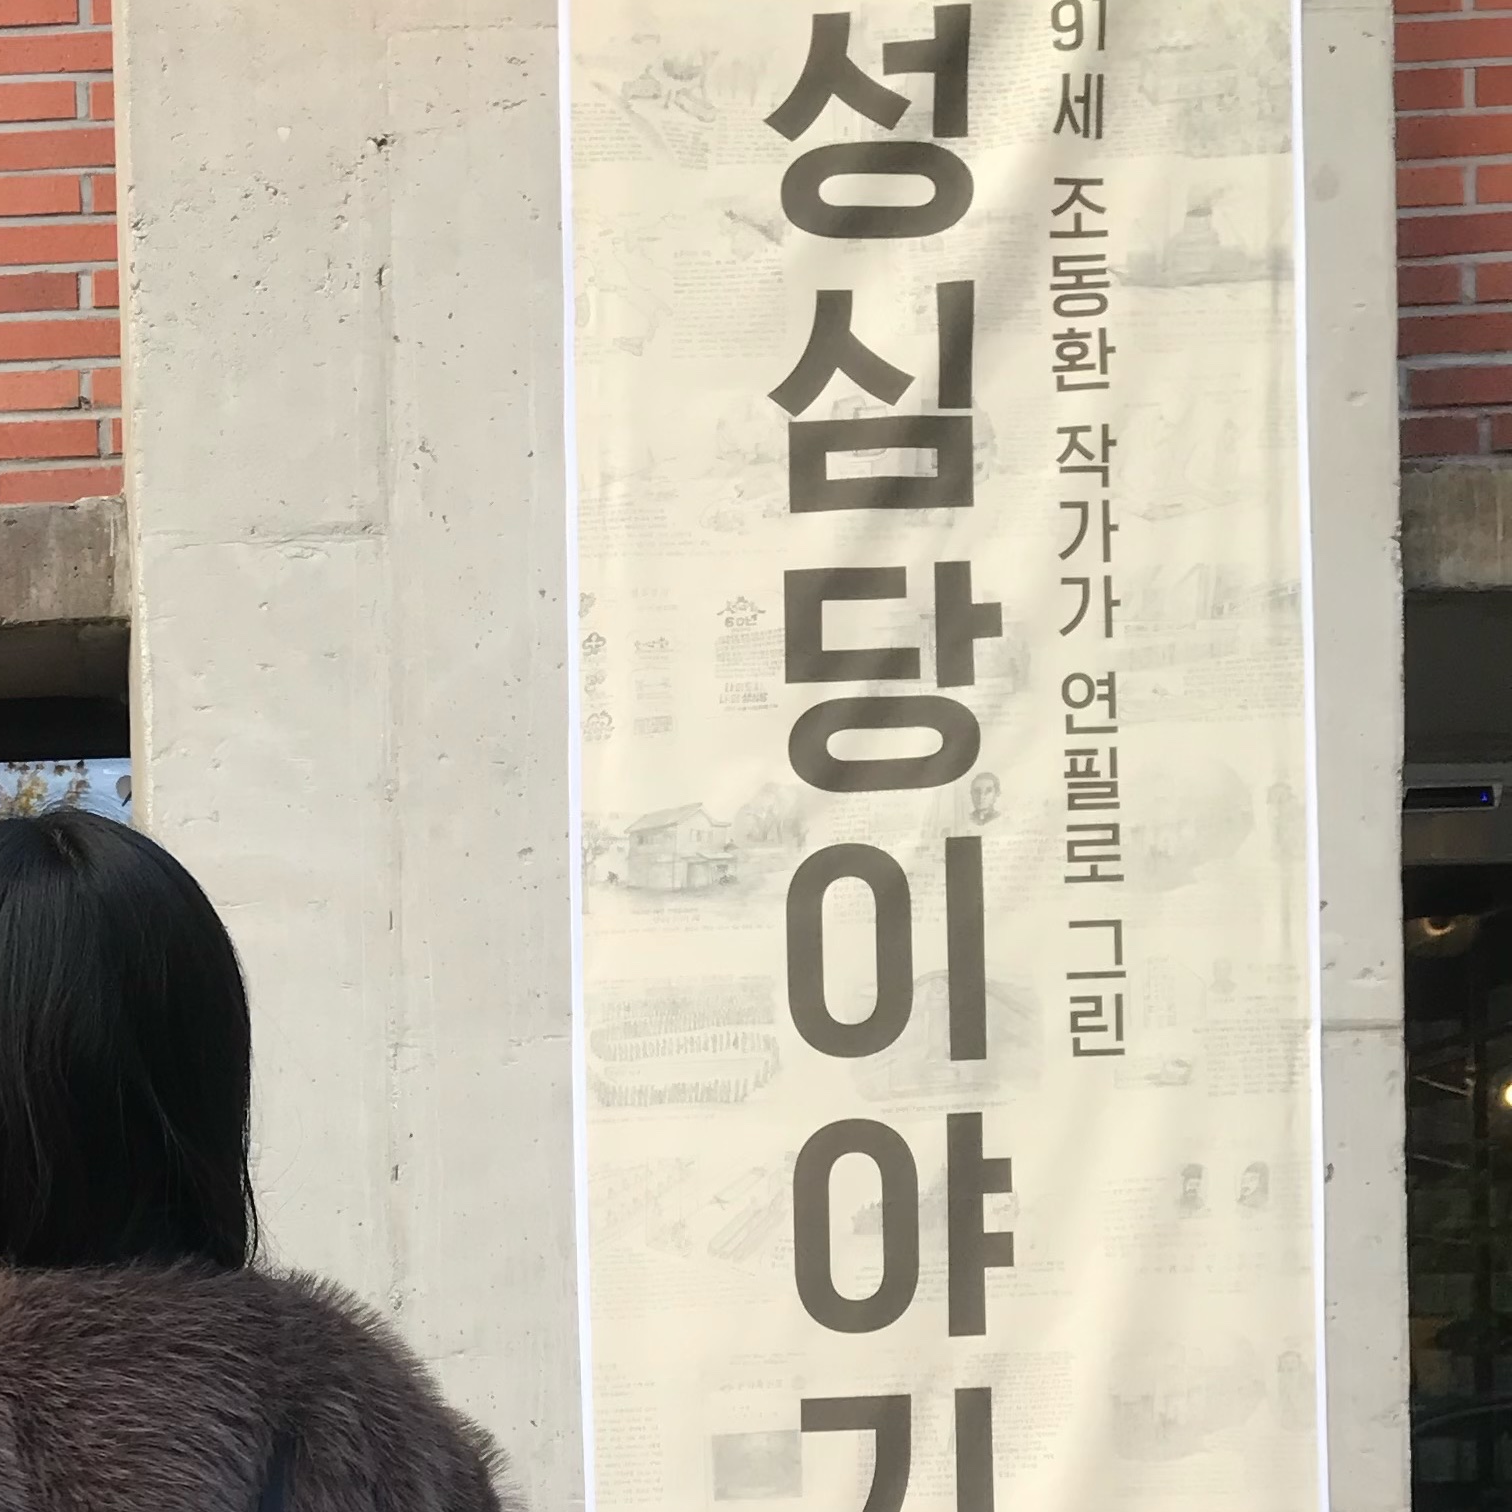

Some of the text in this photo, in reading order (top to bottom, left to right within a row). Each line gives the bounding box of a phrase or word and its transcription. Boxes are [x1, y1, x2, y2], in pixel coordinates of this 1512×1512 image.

[1049, 176, 1116, 392] 조동환
[1055, 423, 1122, 639] 작가가
[1060, 670, 1125, 885] 연필로
[1066, 919, 1126, 1058] 그린
